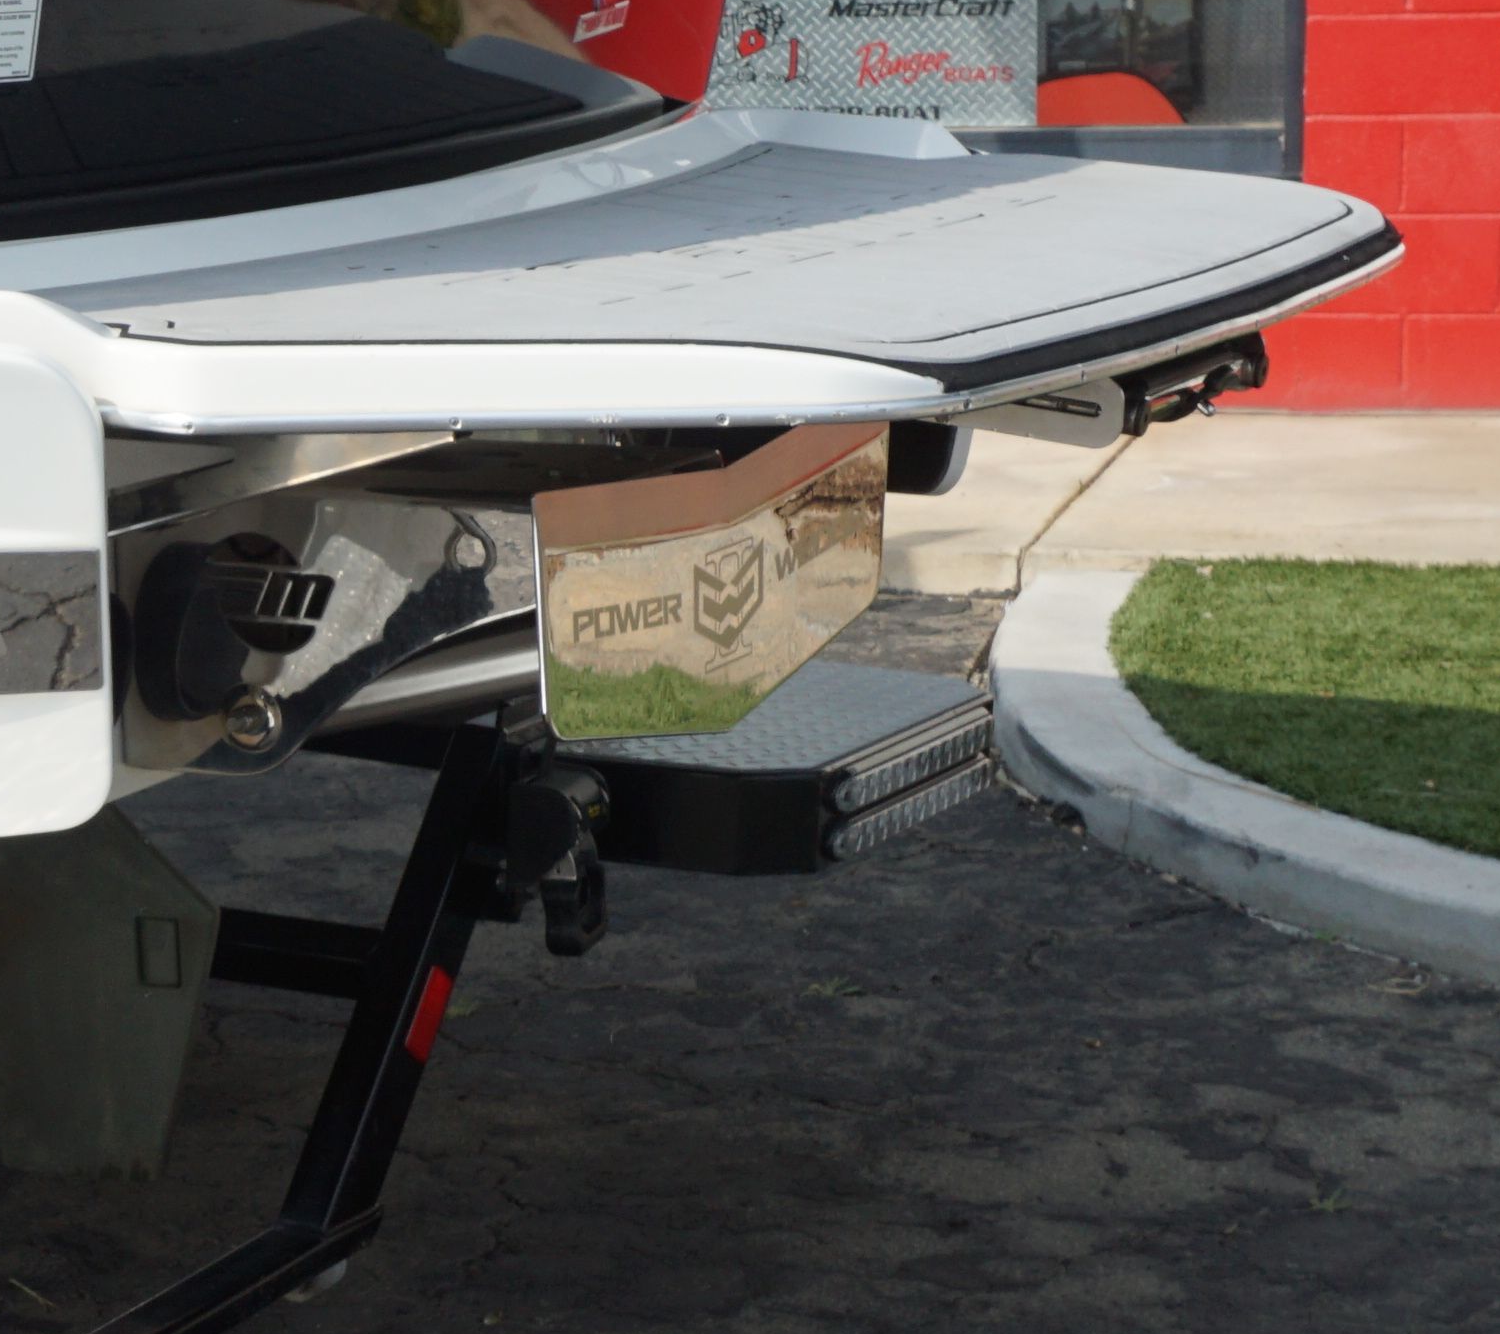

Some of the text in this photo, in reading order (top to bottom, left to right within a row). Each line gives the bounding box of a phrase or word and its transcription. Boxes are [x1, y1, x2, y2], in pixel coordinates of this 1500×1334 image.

[855, 41, 950, 88] Ranger
[943, 65, 1015, 83] BOATS
[572, 593, 683, 644] POWER
